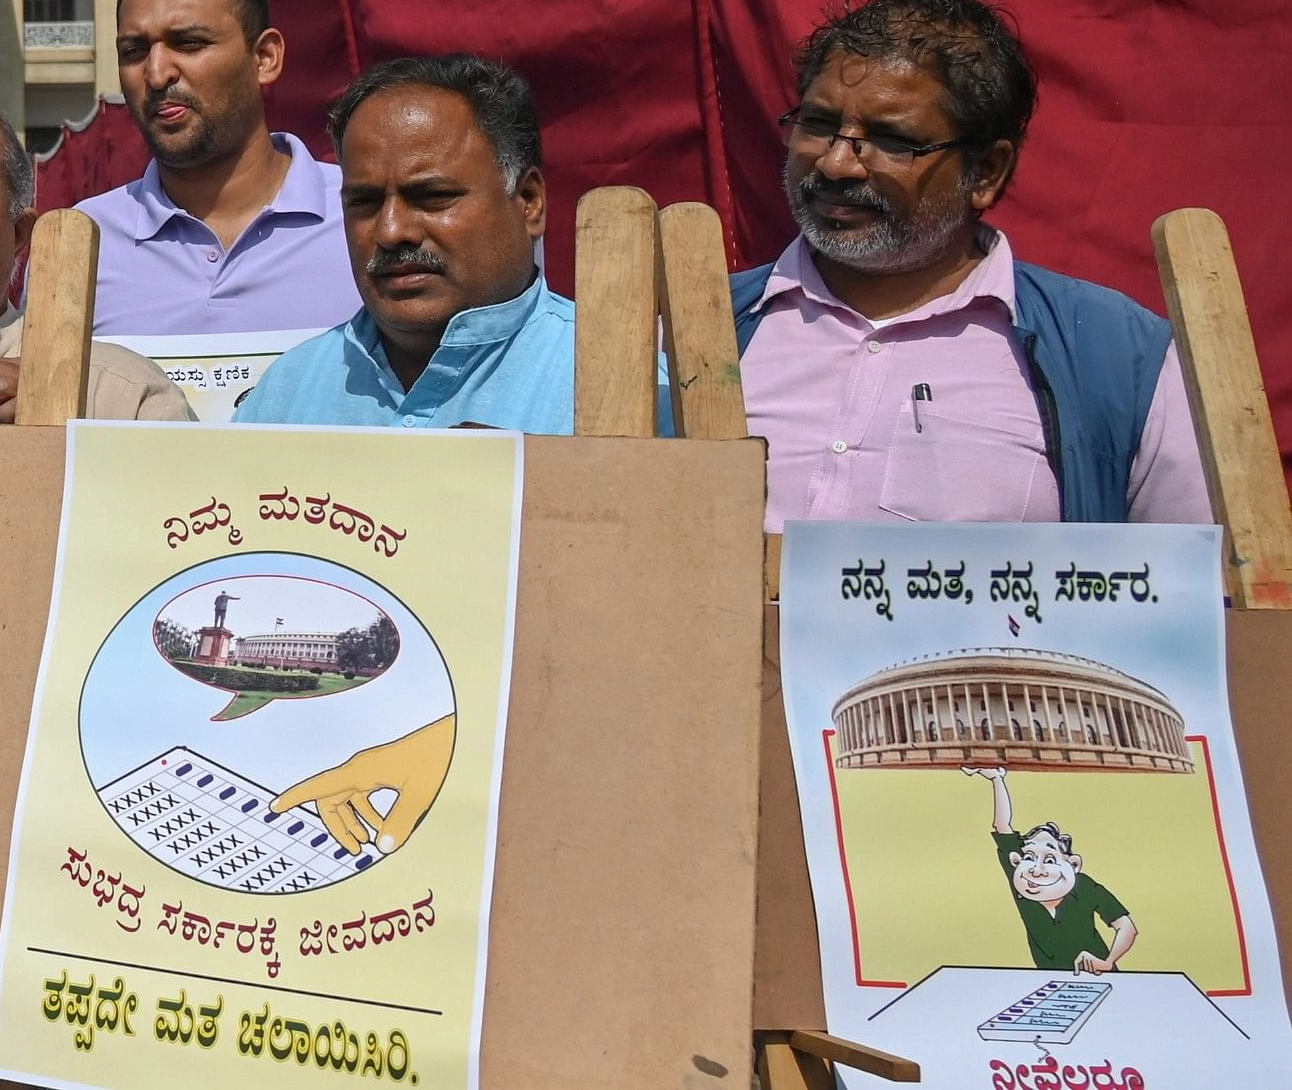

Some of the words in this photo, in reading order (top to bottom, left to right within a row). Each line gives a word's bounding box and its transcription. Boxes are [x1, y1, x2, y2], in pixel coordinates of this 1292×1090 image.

[166, 367, 207, 387] ಯಸ್ಸು
[213, 366, 250, 387] ಕ್ಷಣಿಕ
[163, 496, 243, 549] ನಿಮ್ಮ
[259, 486, 407, 558] ಮತದಾನ
[841, 558, 893, 621] ನನ್ನ
[907, 559, 973, 604] ಮತ,
[990, 560, 1042, 623] ನನ್ನ
[1055, 561, 1158, 603] ಸರ್ಕಾರ.
[60, 846, 146, 933] ಸುಭದ್ರ
[157, 901, 281, 979] ಸರ್ಕಾರಕ್ಕೆ
[300, 888, 437, 956] ಜೀವದಾನ
[41, 969, 137, 1052] ತಪ್ಪದೇ
[154, 988, 223, 1049] ಮತ
